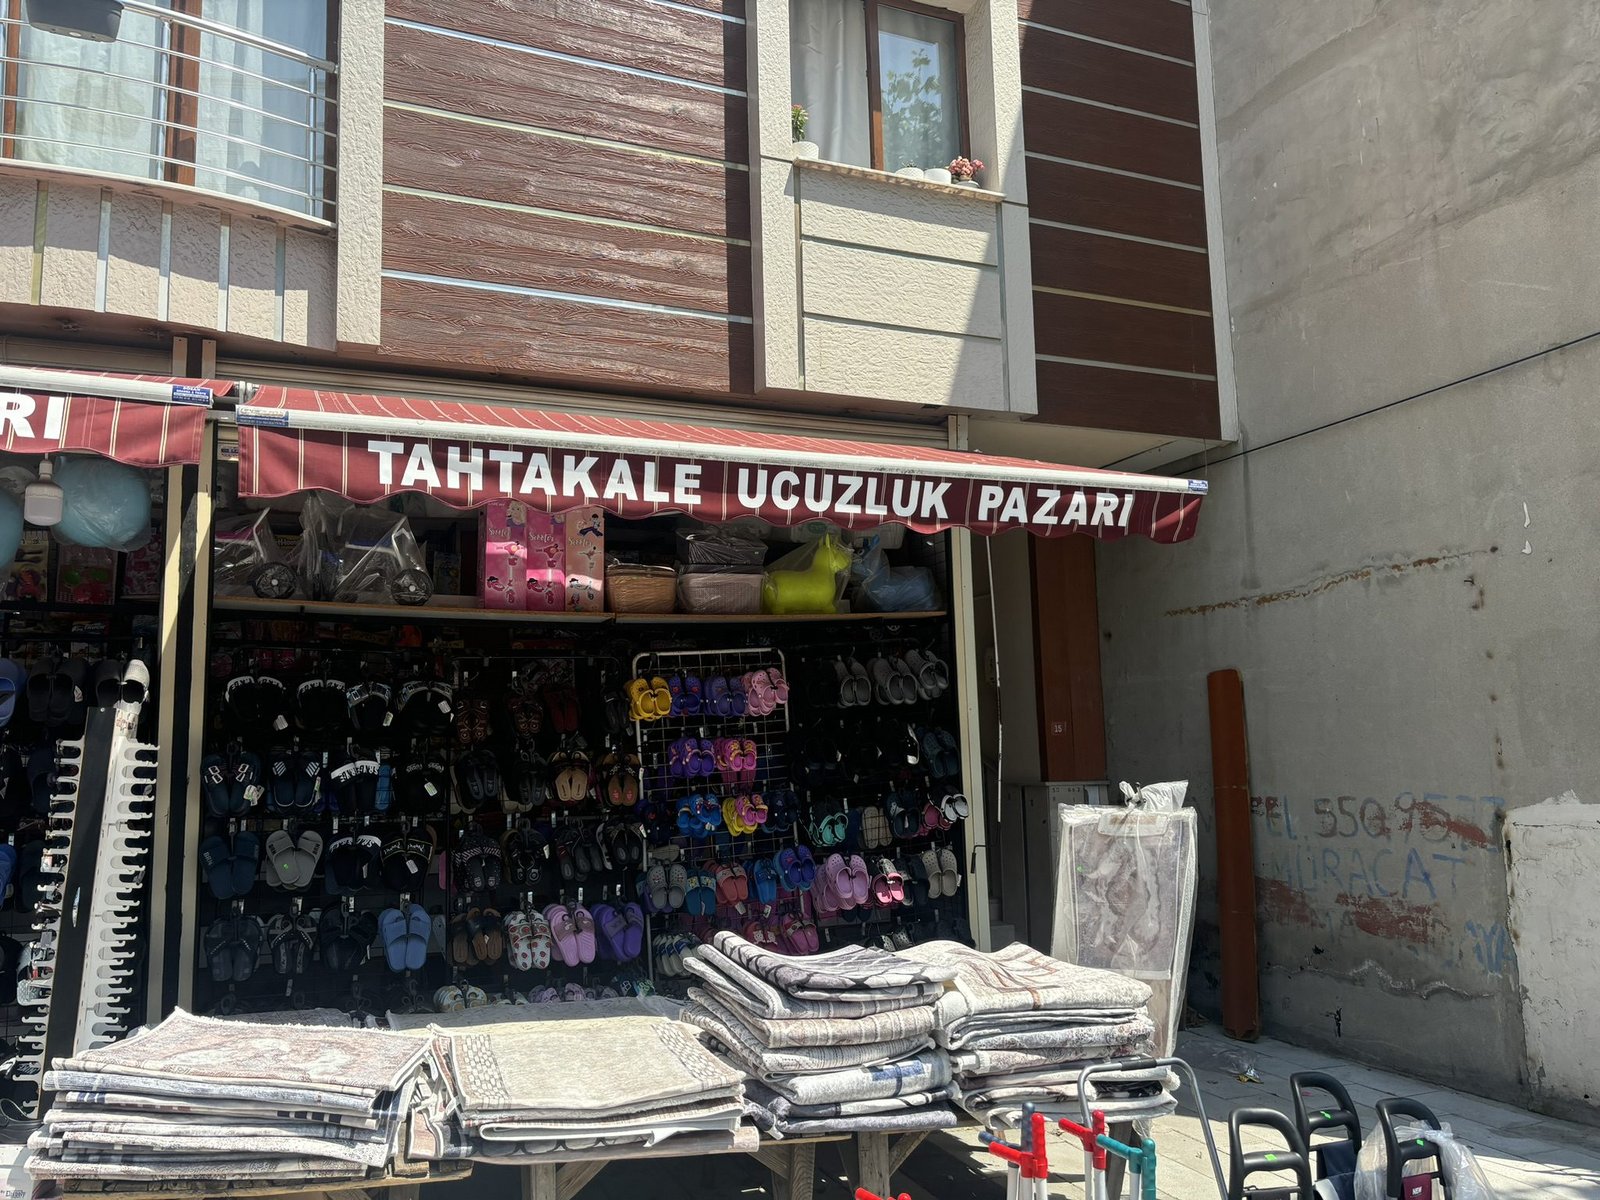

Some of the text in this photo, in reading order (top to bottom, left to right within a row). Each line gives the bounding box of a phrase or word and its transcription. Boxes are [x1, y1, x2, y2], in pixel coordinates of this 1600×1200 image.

[368, 439, 1134, 527] TAHTAKALE UCUZLUK PAZARI
